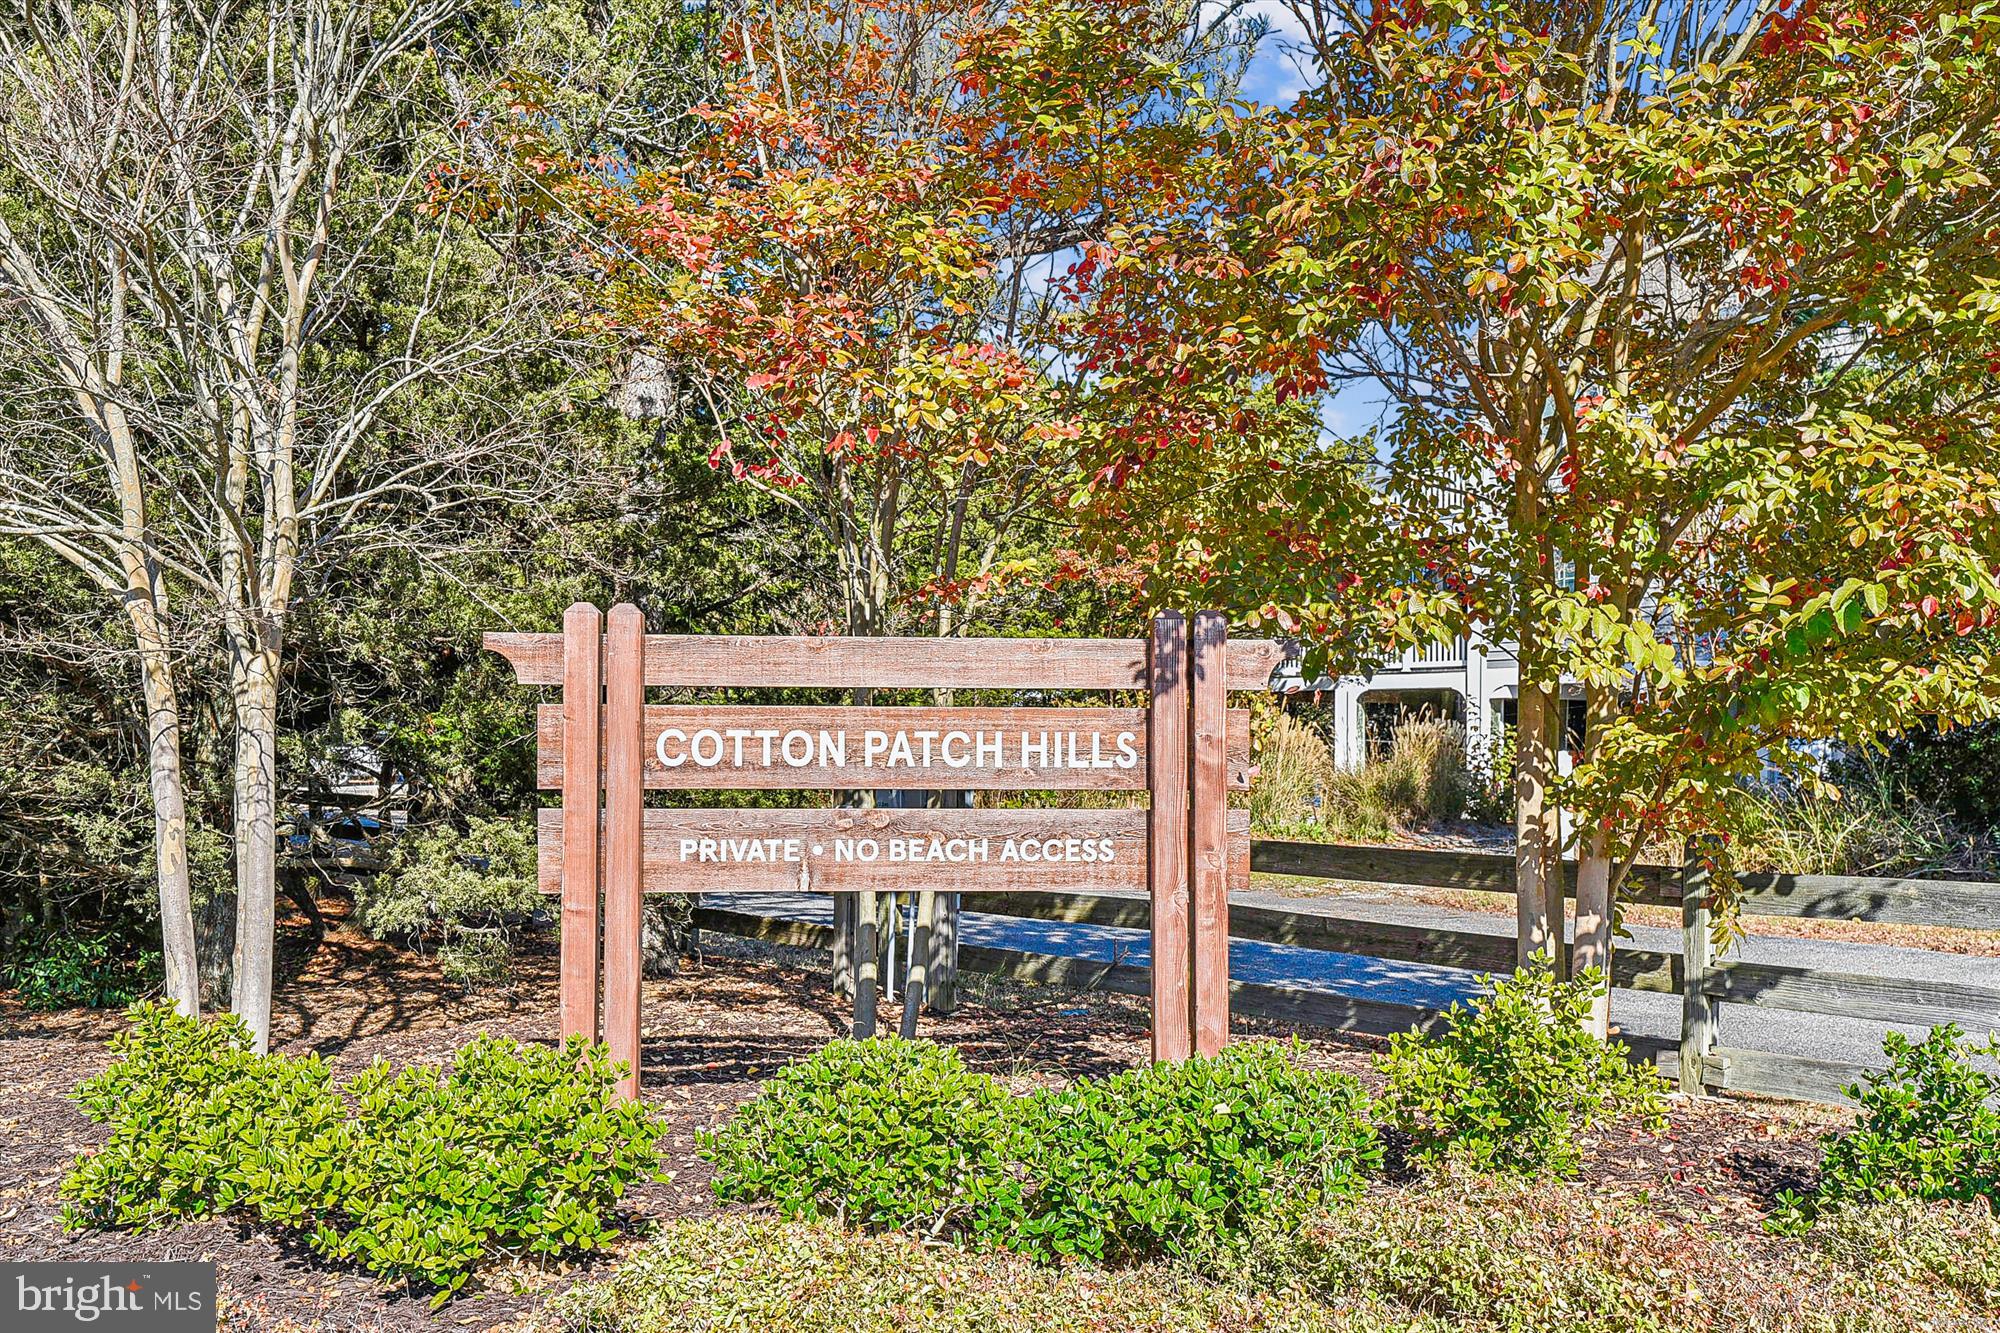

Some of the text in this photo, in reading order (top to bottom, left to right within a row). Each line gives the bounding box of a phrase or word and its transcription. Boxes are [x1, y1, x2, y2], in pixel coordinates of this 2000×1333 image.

[656, 728, 1138, 769] COTTON PATCH HILLS
[679, 839, 1115, 862] PRIVATE NO BEACH ACCESS
